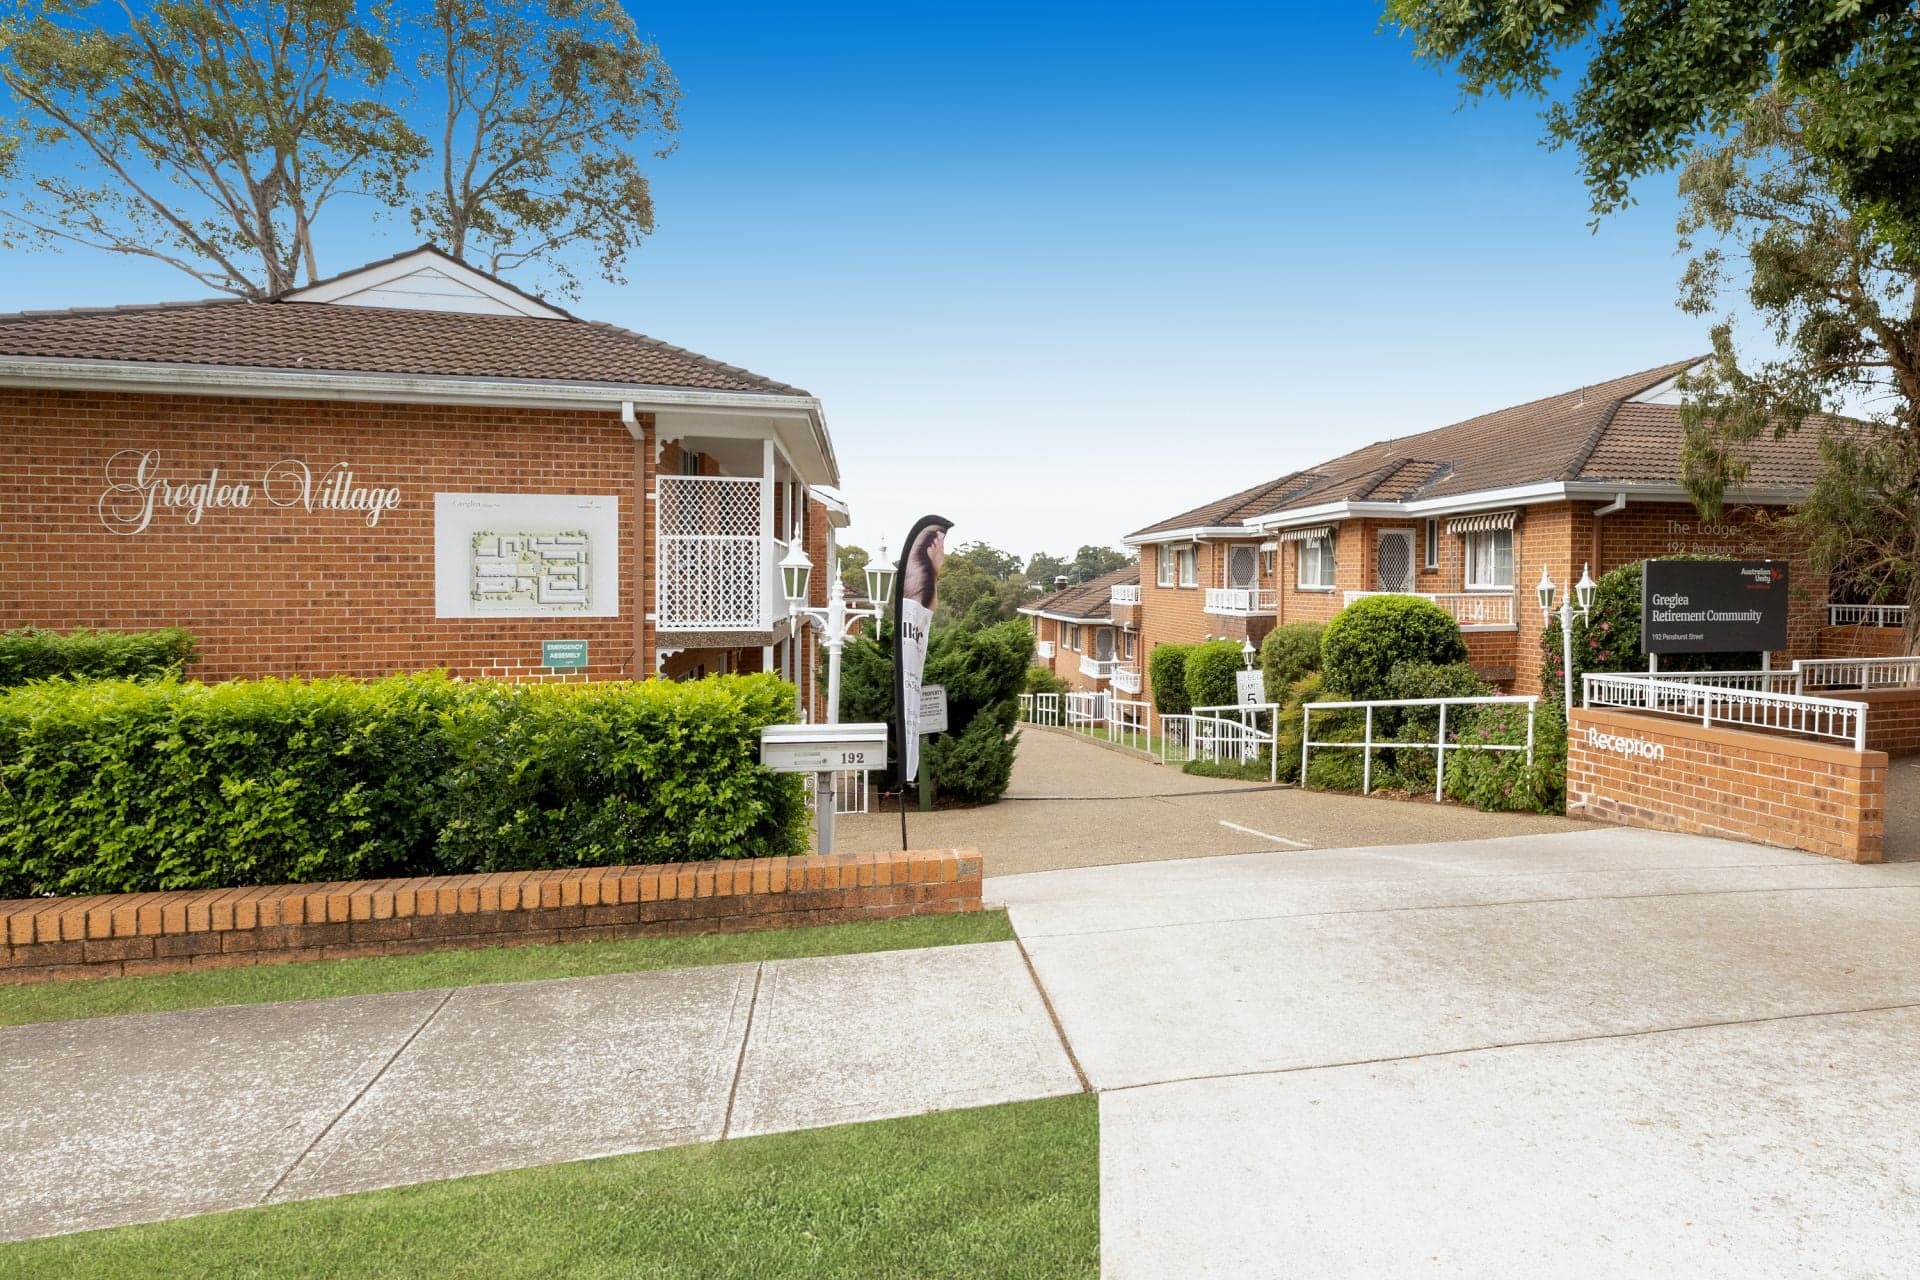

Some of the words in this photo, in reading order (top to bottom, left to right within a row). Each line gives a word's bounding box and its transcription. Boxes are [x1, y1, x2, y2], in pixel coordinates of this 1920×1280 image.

[98, 449, 254, 535] Greglea
[264, 459, 401, 527] Village
[1666, 520, 1690, 535] The
[1741, 568, 1771, 576] Australian
[1755, 575, 1771, 583] Unity
[1652, 593, 1689, 609] Greglea
[1652, 610, 1706, 622] Retirement
[1706, 609, 1762, 624] Community
[1247, 693, 1257, 704] 5
[1589, 727, 1664, 761] Reception
[841, 753, 865, 764] 192
